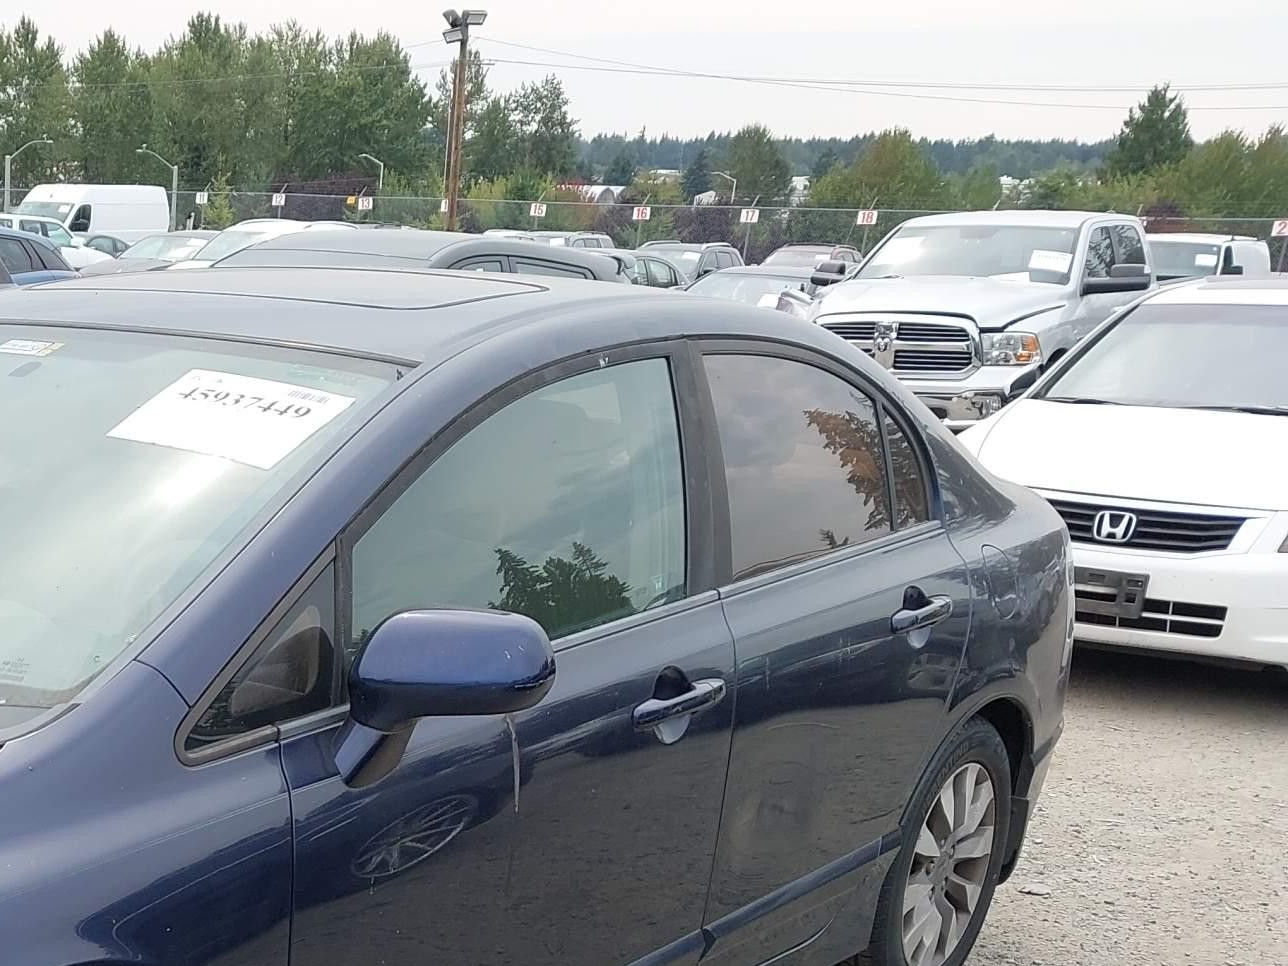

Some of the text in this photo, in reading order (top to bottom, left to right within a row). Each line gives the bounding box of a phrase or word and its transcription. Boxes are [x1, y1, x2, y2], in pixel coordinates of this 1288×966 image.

[275, 194, 283, 204] 12
[361, 197, 369, 209] 13
[533, 203, 544, 216] 15
[635, 207, 647, 219] 16
[744, 210, 755, 222] 17
[862, 211, 873, 224] 18
[1276, 221, 1288, 235] 2
[178, 386, 312, 419] 45937449
